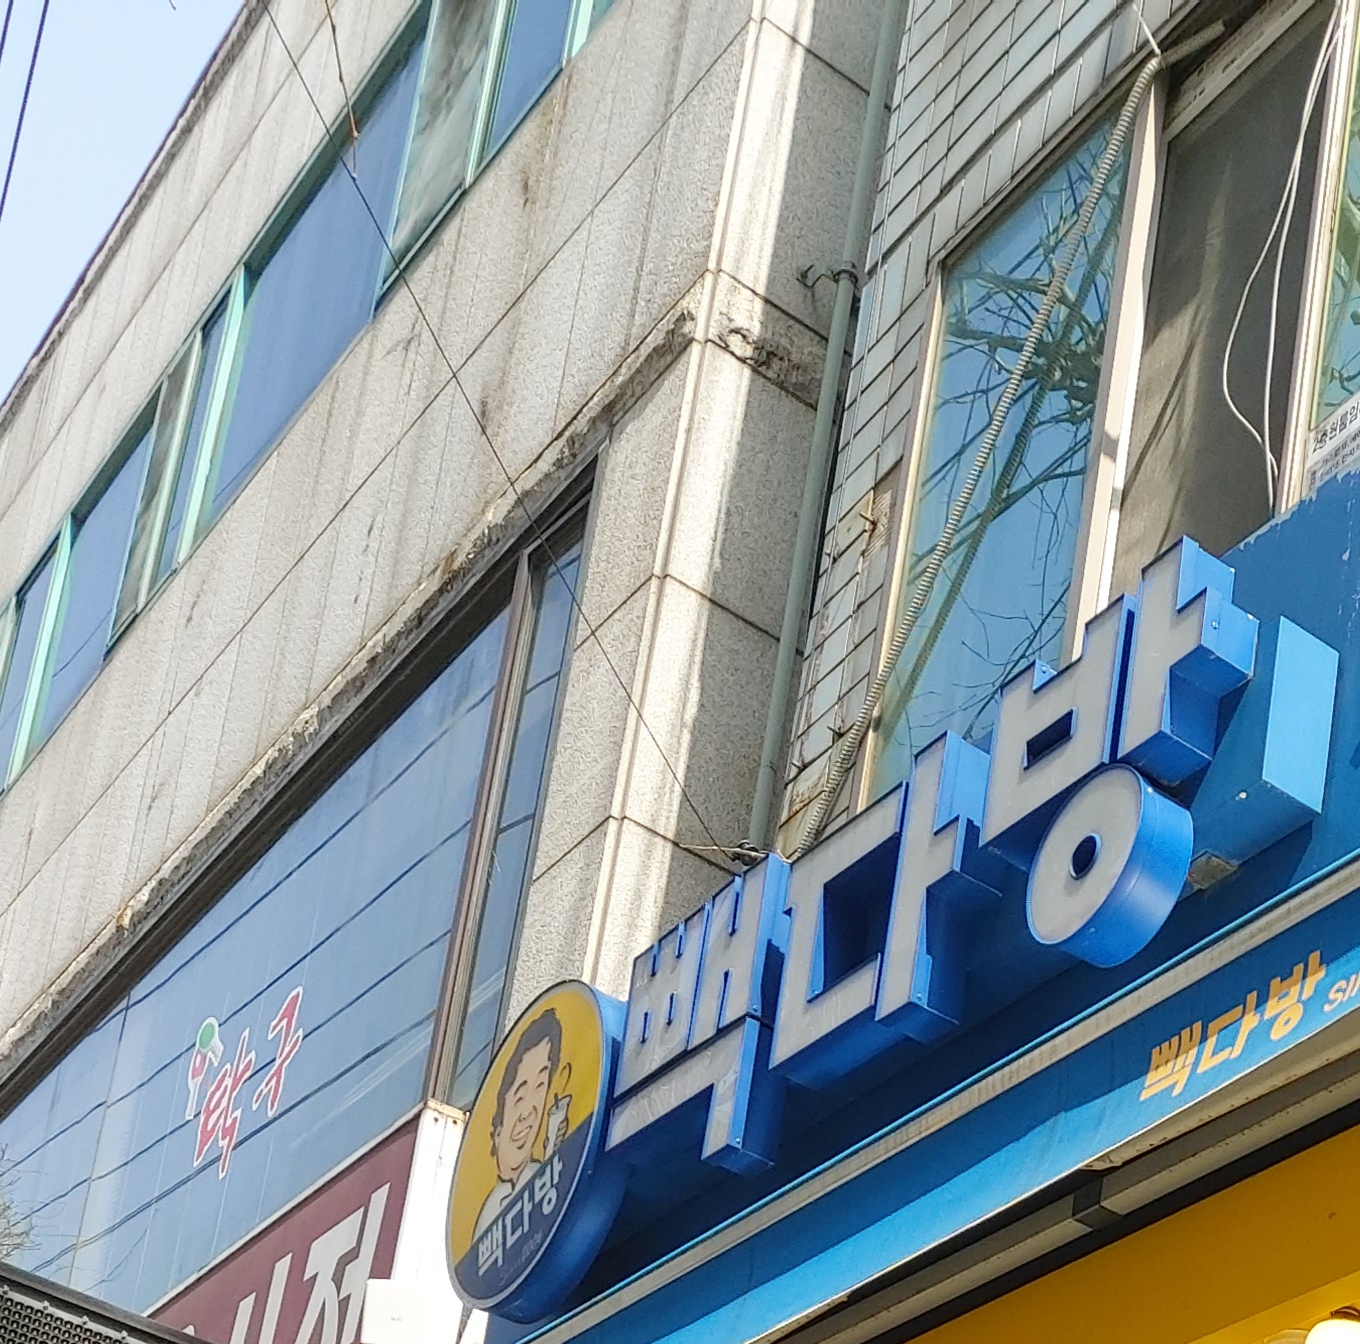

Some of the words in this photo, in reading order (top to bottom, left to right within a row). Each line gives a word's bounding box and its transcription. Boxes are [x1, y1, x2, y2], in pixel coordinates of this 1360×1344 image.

[605, 537, 1255, 1170] 빽다방
[193, 985, 304, 1180] 탁구
[1138, 950, 1329, 1103] 빽다방
[478, 1153, 563, 1277] 빽다방
